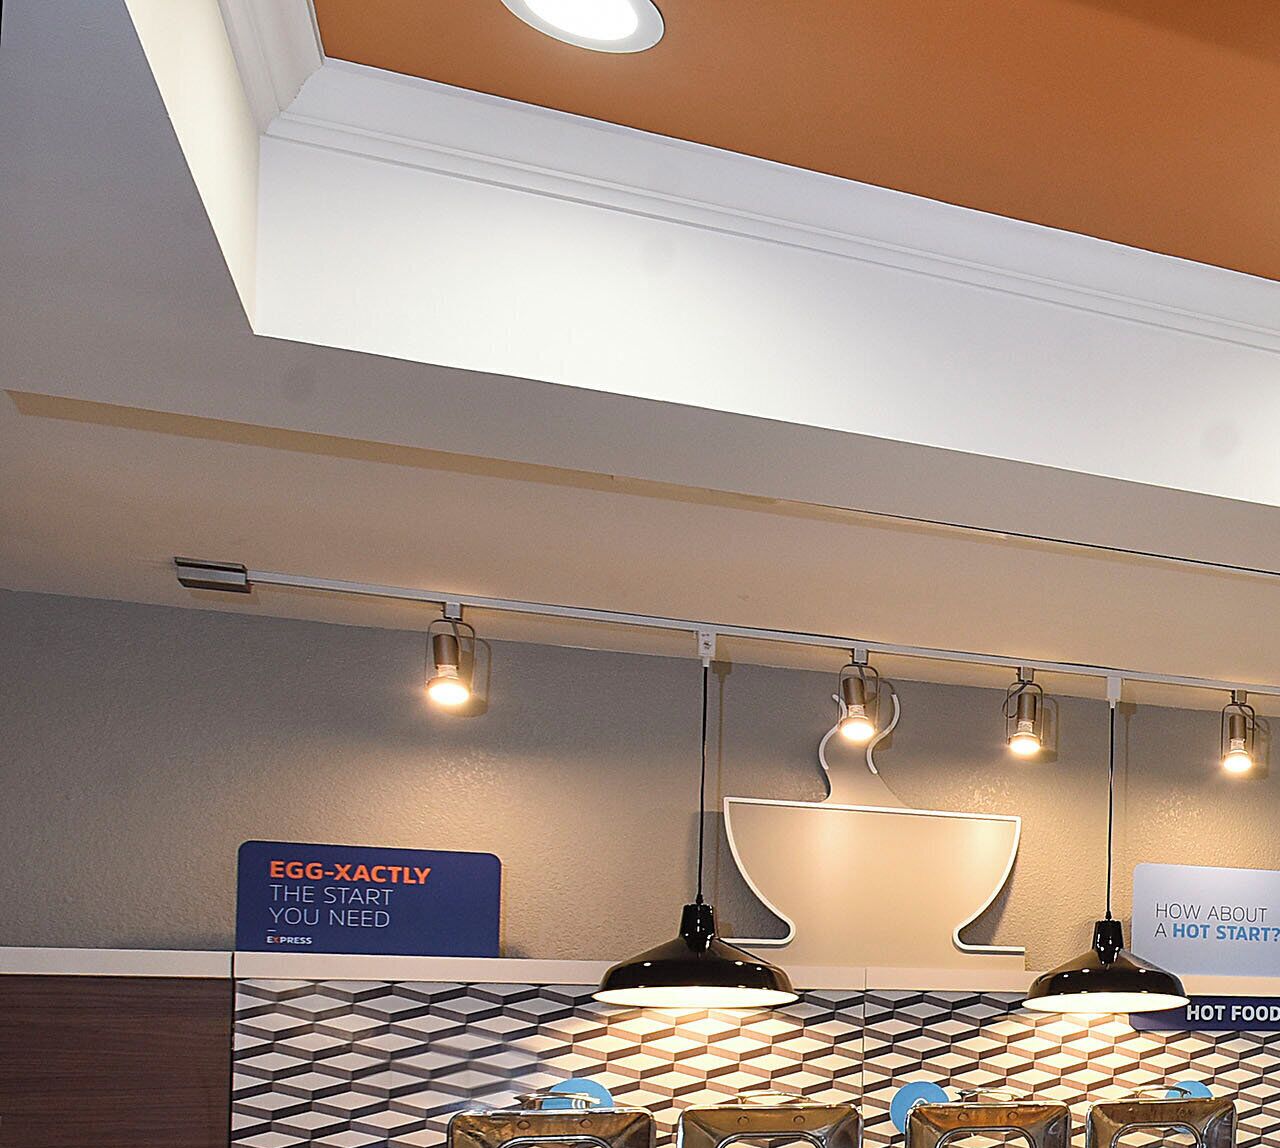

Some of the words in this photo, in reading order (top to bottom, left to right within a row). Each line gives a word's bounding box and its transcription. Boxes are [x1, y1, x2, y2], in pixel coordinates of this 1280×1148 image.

[270, 860, 431, 885] EGG-XACTLY
[269, 884, 315, 903] THE
[323, 886, 394, 906] START
[268, 906, 320, 926] YOU
[329, 908, 391, 928] NEED
[1155, 903, 1201, 920] HOW
[1207, 905, 1268, 923] ABOUT
[266, 935, 313, 945] EXPRESS
[1154, 922, 1167, 938] A
[1172, 923, 1211, 939] HOT
[1216, 925, 1280, 942] START?
[1186, 1004, 1226, 1021] HOT
